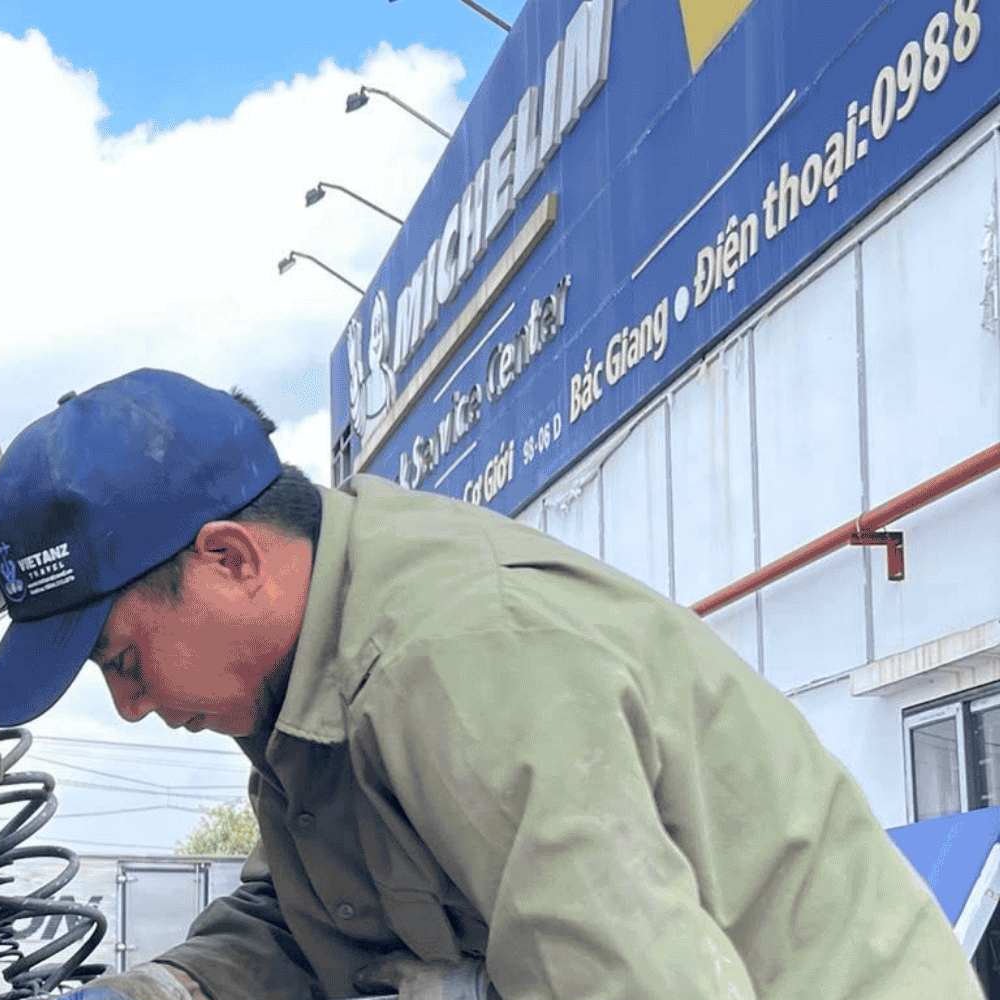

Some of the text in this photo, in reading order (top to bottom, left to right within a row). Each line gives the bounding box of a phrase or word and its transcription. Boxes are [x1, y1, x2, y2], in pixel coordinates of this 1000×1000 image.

[393, 0, 614, 373] MICHELIN
[412, 275, 571, 490] Service Center
[569, 348, 603, 423] Bắc
[605, 297, 669, 385] Giang
[694, 214, 759, 308] Điện
[18, 542, 70, 572] VIETANZ
